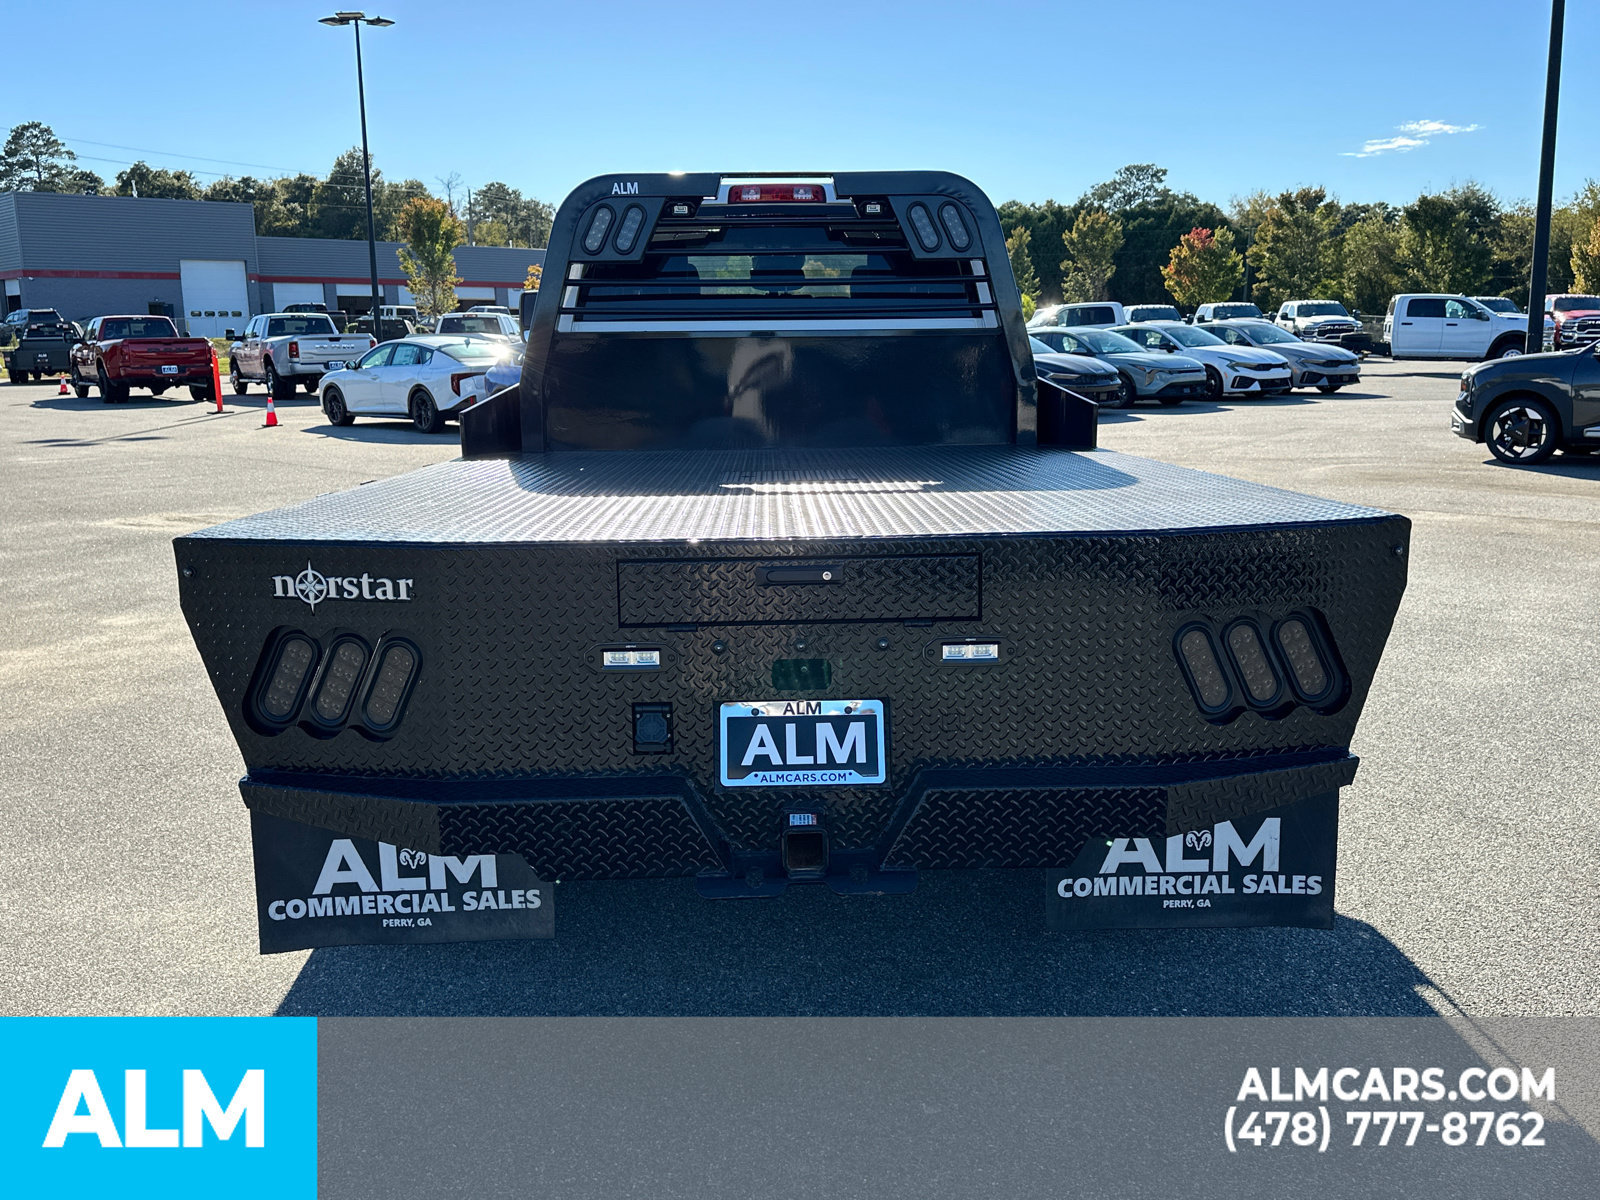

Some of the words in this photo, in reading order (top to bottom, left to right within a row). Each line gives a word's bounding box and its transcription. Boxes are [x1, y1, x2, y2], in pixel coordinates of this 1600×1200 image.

[611, 182, 639, 195] ALM
[272, 564, 414, 609] norstar
[783, 702, 822, 715] ALM
[741, 722, 867, 766] ALM
[760, 773, 847, 783] ALMCARS.COM
[1099, 817, 1281, 874] ALM
[312, 838, 498, 895] ALM
[1057, 874, 1235, 898] COMMERCIAL
[1242, 875, 1322, 895] SALES
[268, 892, 456, 921] COMMERCIAL
[463, 889, 542, 912] SALES
[1163, 900, 1195, 909] PERRY,
[1196, 900, 1211, 908] GA
[382, 918, 415, 928] PERRY,
[417, 918, 432, 927] GA
